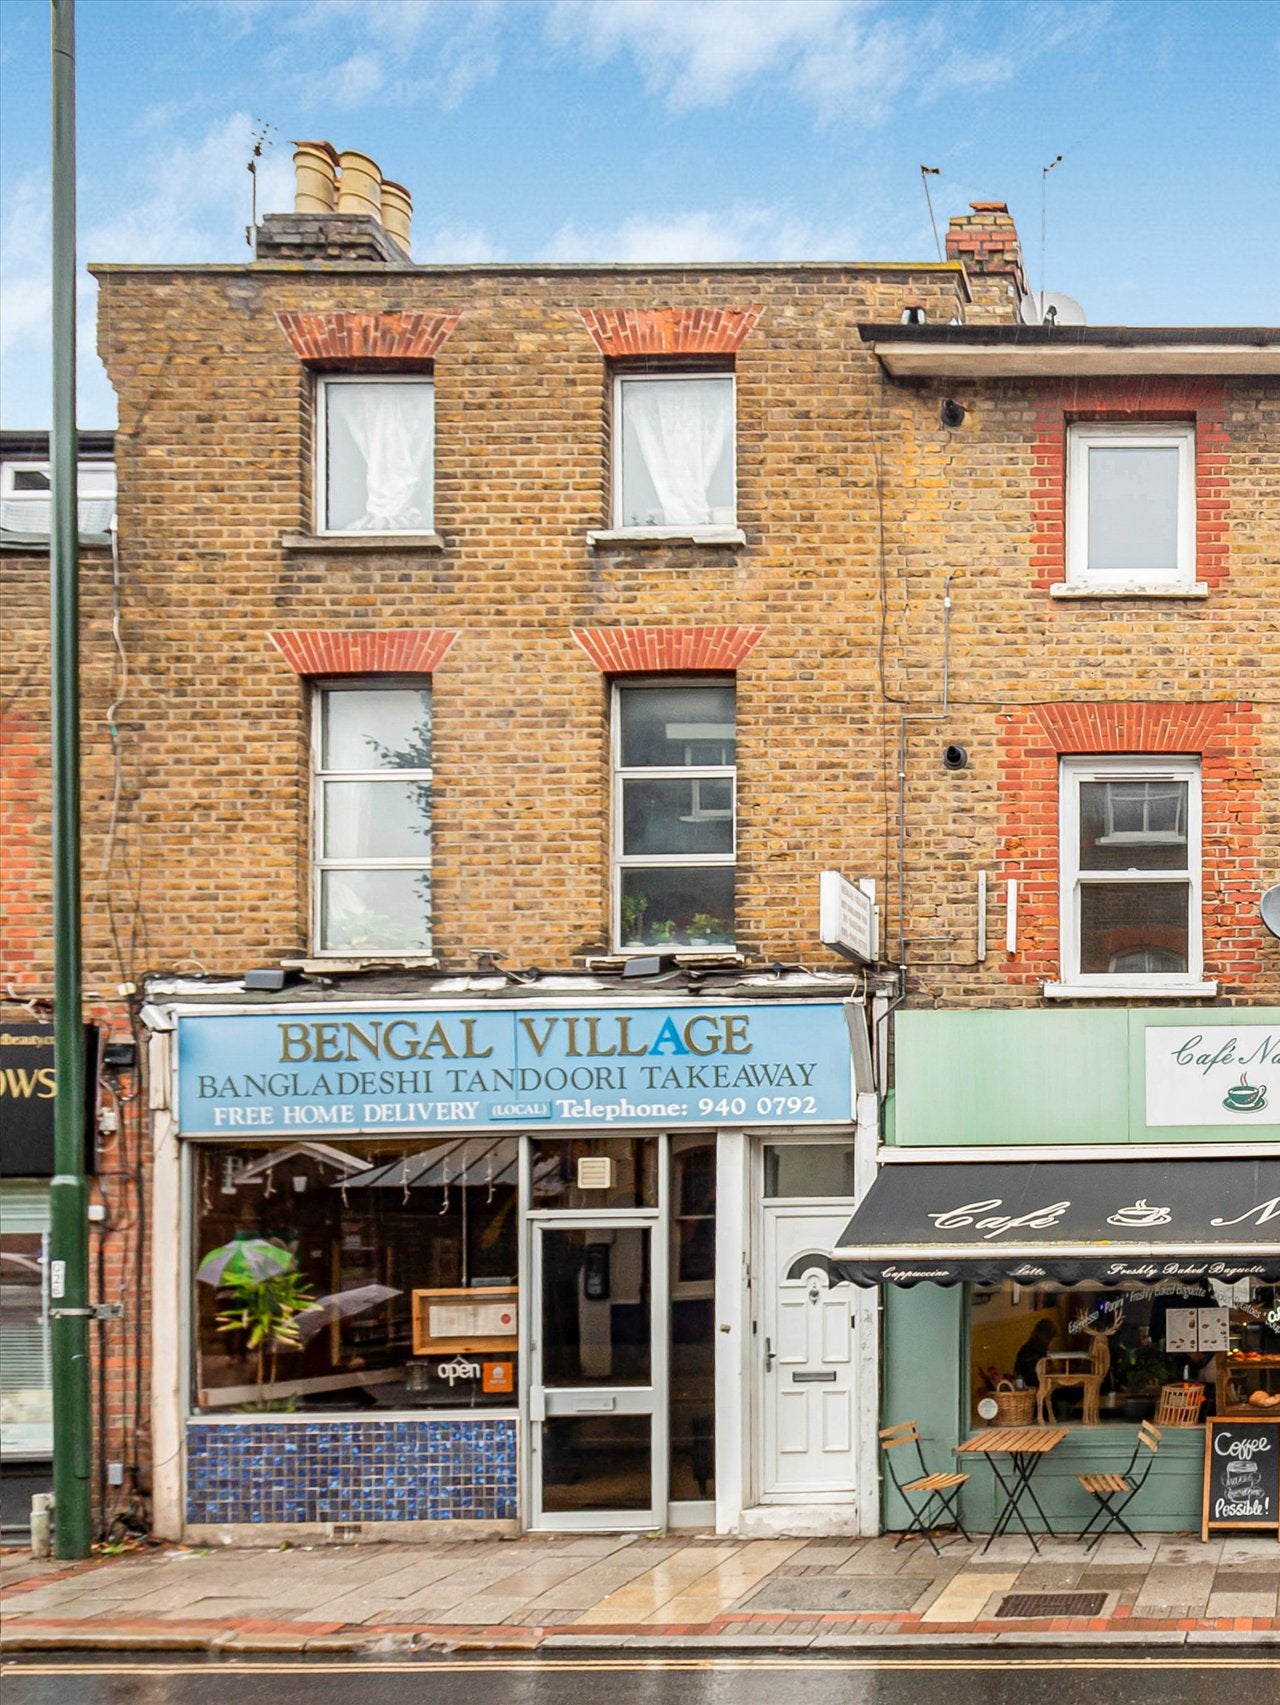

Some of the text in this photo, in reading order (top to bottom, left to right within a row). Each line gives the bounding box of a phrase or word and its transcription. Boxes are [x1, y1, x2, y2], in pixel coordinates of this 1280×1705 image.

[277, 1014, 754, 1063] BENGAL VILLAGE
[1171, 1034, 1238, 1075] Café
[198, 1062, 818, 1099] BANGLADESHI TANDOORI TAKEAWAY
[214, 1096, 818, 1126] FREE HOME DELIVERY (LOCAL) Telephone: 940 0792
[880, 1266, 949, 1281] Cappuccino
[1007, 1264, 1047, 1276] Latte
[1107, 1263, 1158, 1277] Freshly
[1162, 1263, 1208, 1275] Baked
[1208, 1262, 1266, 1277] Baguette
[437, 1363, 481, 1387] open
[1214, 1432, 1271, 1459] Coffee
[1214, 1497, 1270, 1518] Possible!
